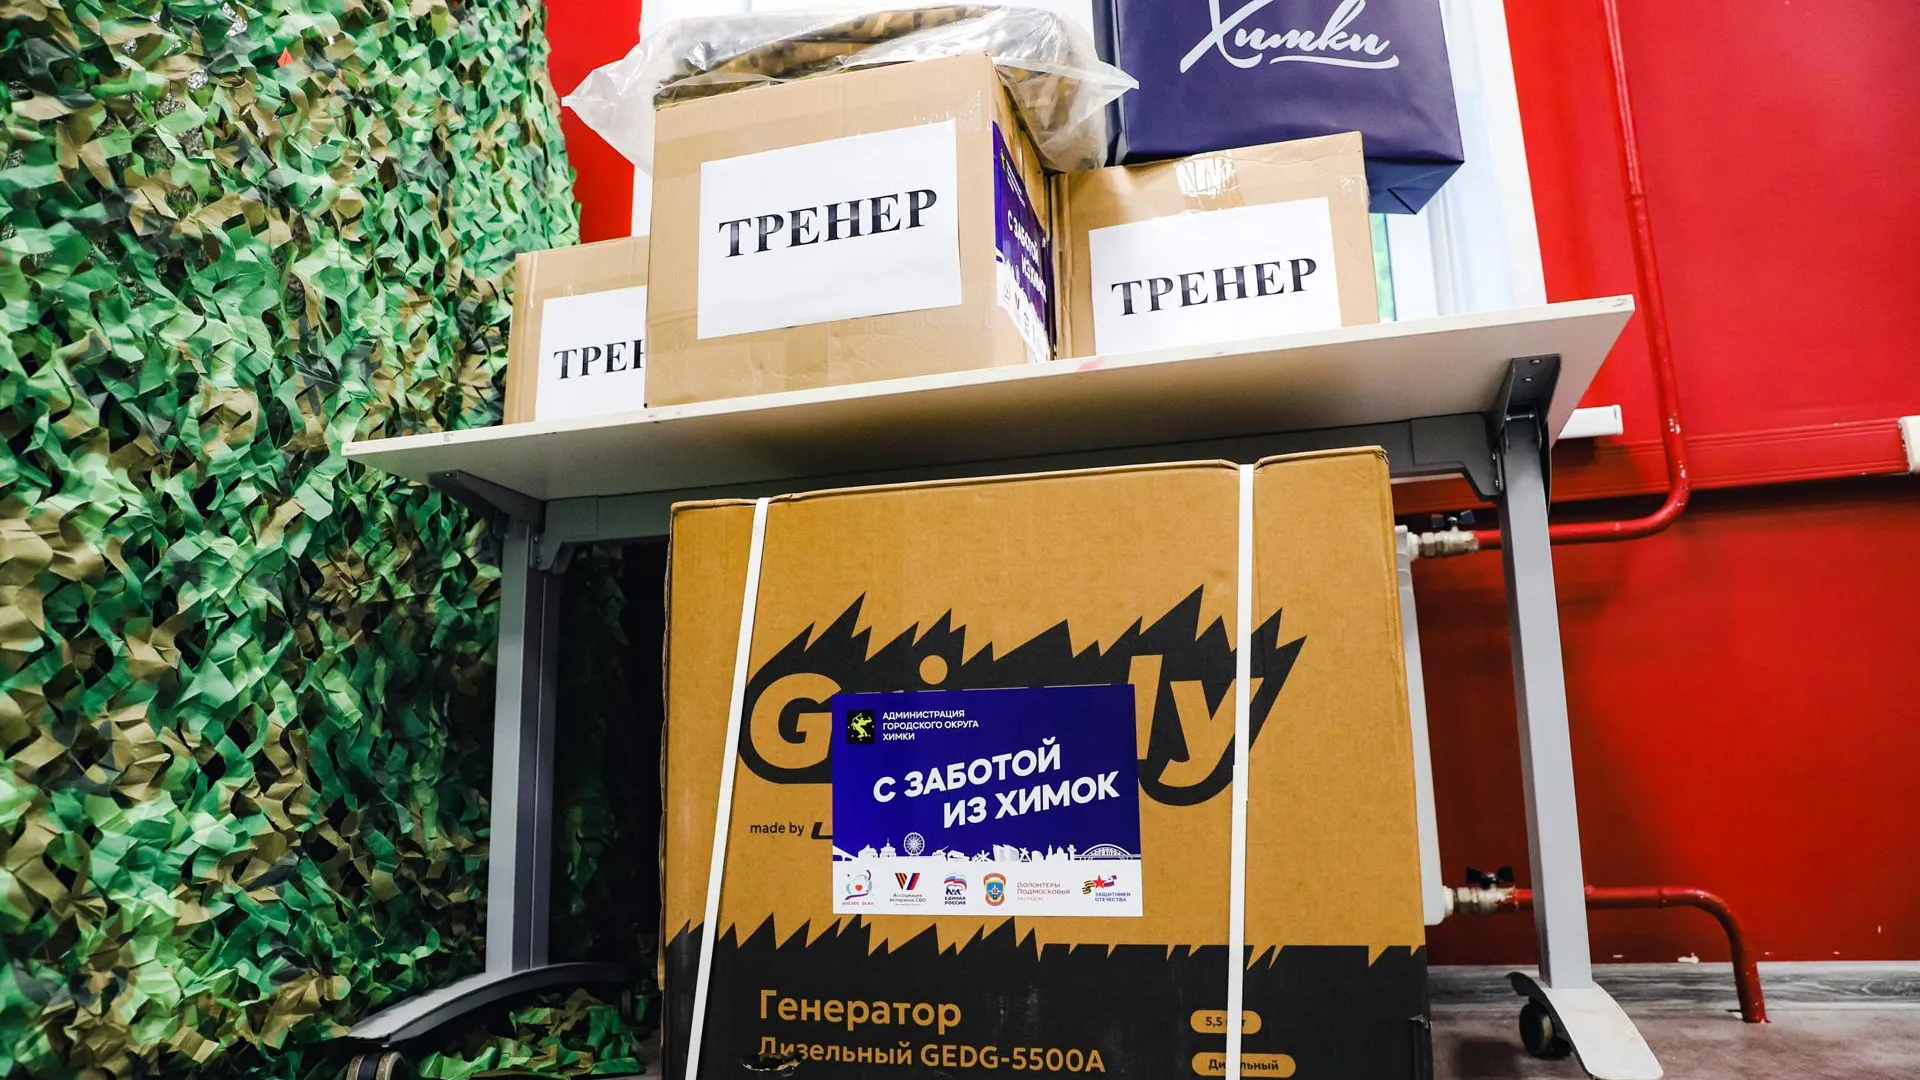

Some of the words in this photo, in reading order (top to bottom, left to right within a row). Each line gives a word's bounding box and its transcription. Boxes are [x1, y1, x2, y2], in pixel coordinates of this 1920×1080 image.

[718, 188, 938, 258] ТРЕНЕР
[1111, 257, 1317, 317] ТРЕНЕР
[553, 339, 645, 380] ТРЕ
[882, 709, 965, 721] АДМИНИСТРАЦИЯ
[882, 721, 943, 731] ГОРОДСКОГО
[944, 720, 979, 729] ОКРУГА
[882, 733, 915, 741] ХИМКИ
[873, 776, 896, 803] С
[904, 736, 1061, 798] ЗАБОТОЙ
[943, 797, 987, 829] ИЗ
[994, 771, 1120, 819] ХИМОК
[750, 823, 786, 834] made
[789, 823, 805, 837] by
[760, 989, 962, 1035] Генератор
[1205, 1016, 1223, 1028] 5,5
[758, 1036, 913, 1065] Дизельный
[920, 1044, 1106, 1073] GEDG-5500A
[1208, 1058, 1279, 1072] Дильный
